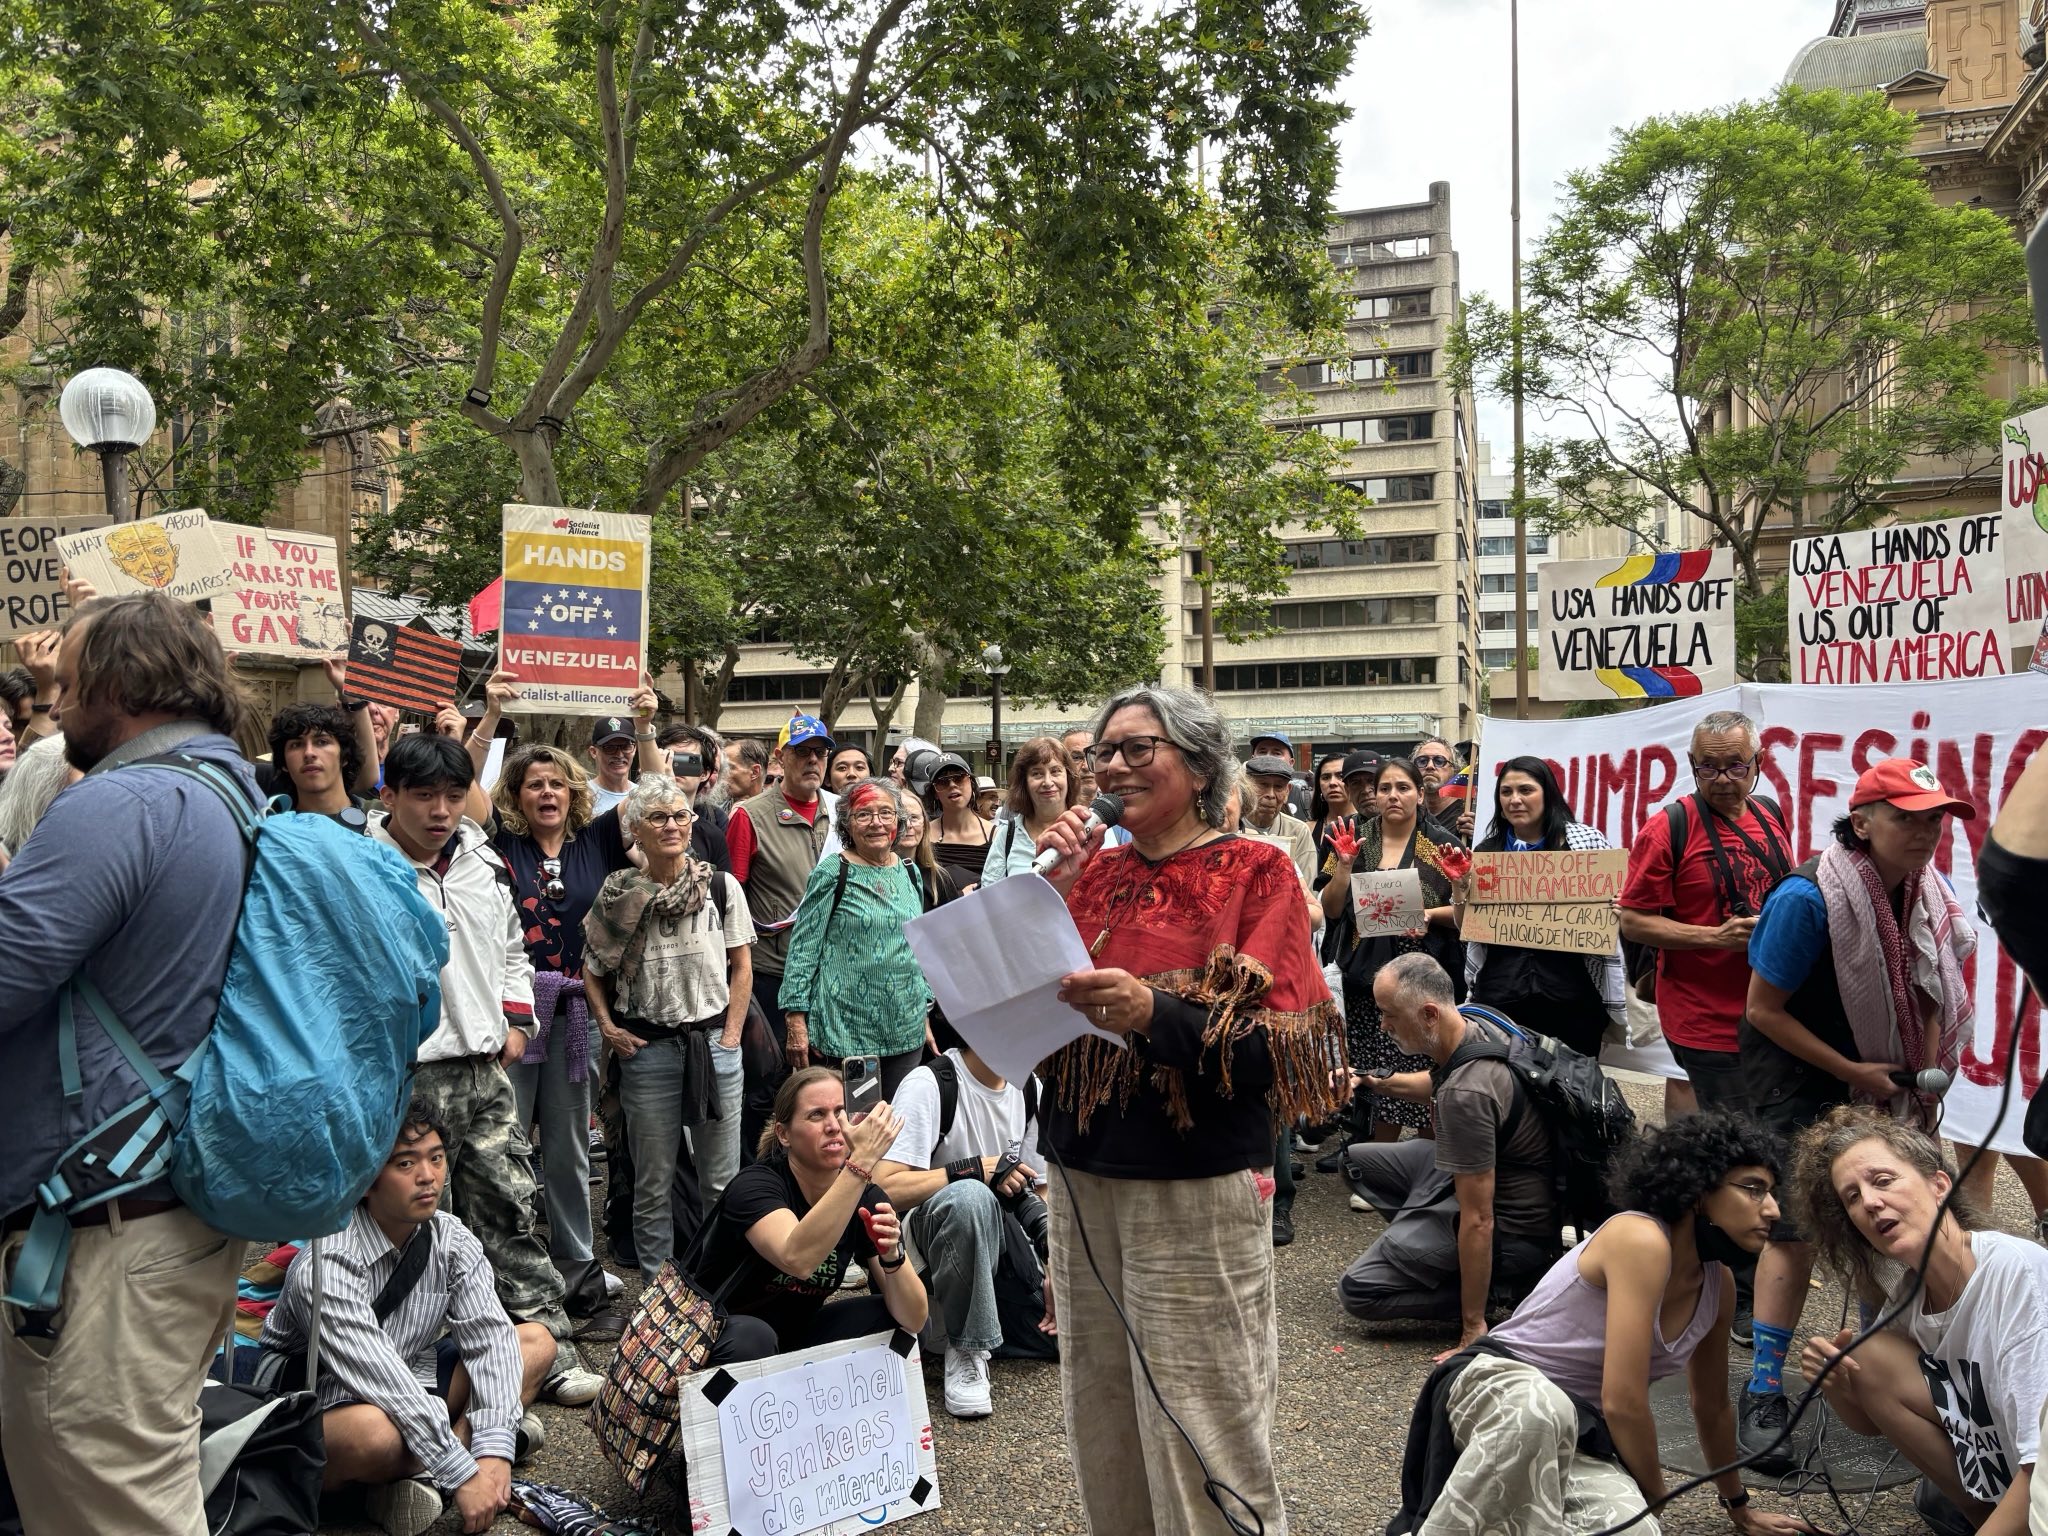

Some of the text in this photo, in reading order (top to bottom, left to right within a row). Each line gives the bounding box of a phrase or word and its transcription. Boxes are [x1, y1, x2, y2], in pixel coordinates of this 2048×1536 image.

[166, 515, 203, 530] ABOUT
[568, 520, 600, 530] Socialist
[568, 527, 599, 536] Alliance
[61, 535, 102, 559] WHAT
[236, 535, 318, 565] IF YOU
[1872, 524, 1950, 566] HANDS
[1959, 516, 2002, 556] OFF
[524, 544, 626, 572] HANDS
[232, 562, 338, 591] ARREST ME
[1803, 557, 1972, 608] VENEZUELA
[551, 604, 598, 623] OFF
[1552, 578, 1733, 621] USA HANDS OFF
[231, 614, 300, 645] GAY
[1849, 601, 1900, 639] OUT
[1913, 597, 1948, 634] OF
[505, 649, 637, 671] VENEZUELA
[1552, 622, 1713, 670] VENEZUELA
[1800, 629, 2005, 684] LATIN AMERICA
[519, 688, 635, 706] cialist-alliance.org
[1560, 853, 1599, 874] OFF
[1536, 870, 1622, 900] AMERICA!
[1363, 913, 1424, 932] GRINGOS
[1542, 904, 1563, 922] AL
[1566, 906, 1619, 930] CARAJO
[1546, 928, 1561, 945] DE
[806, 1377, 844, 1416] to
[845, 1353, 903, 1408] hell
[763, 1442, 914, 1535] de mierda!
